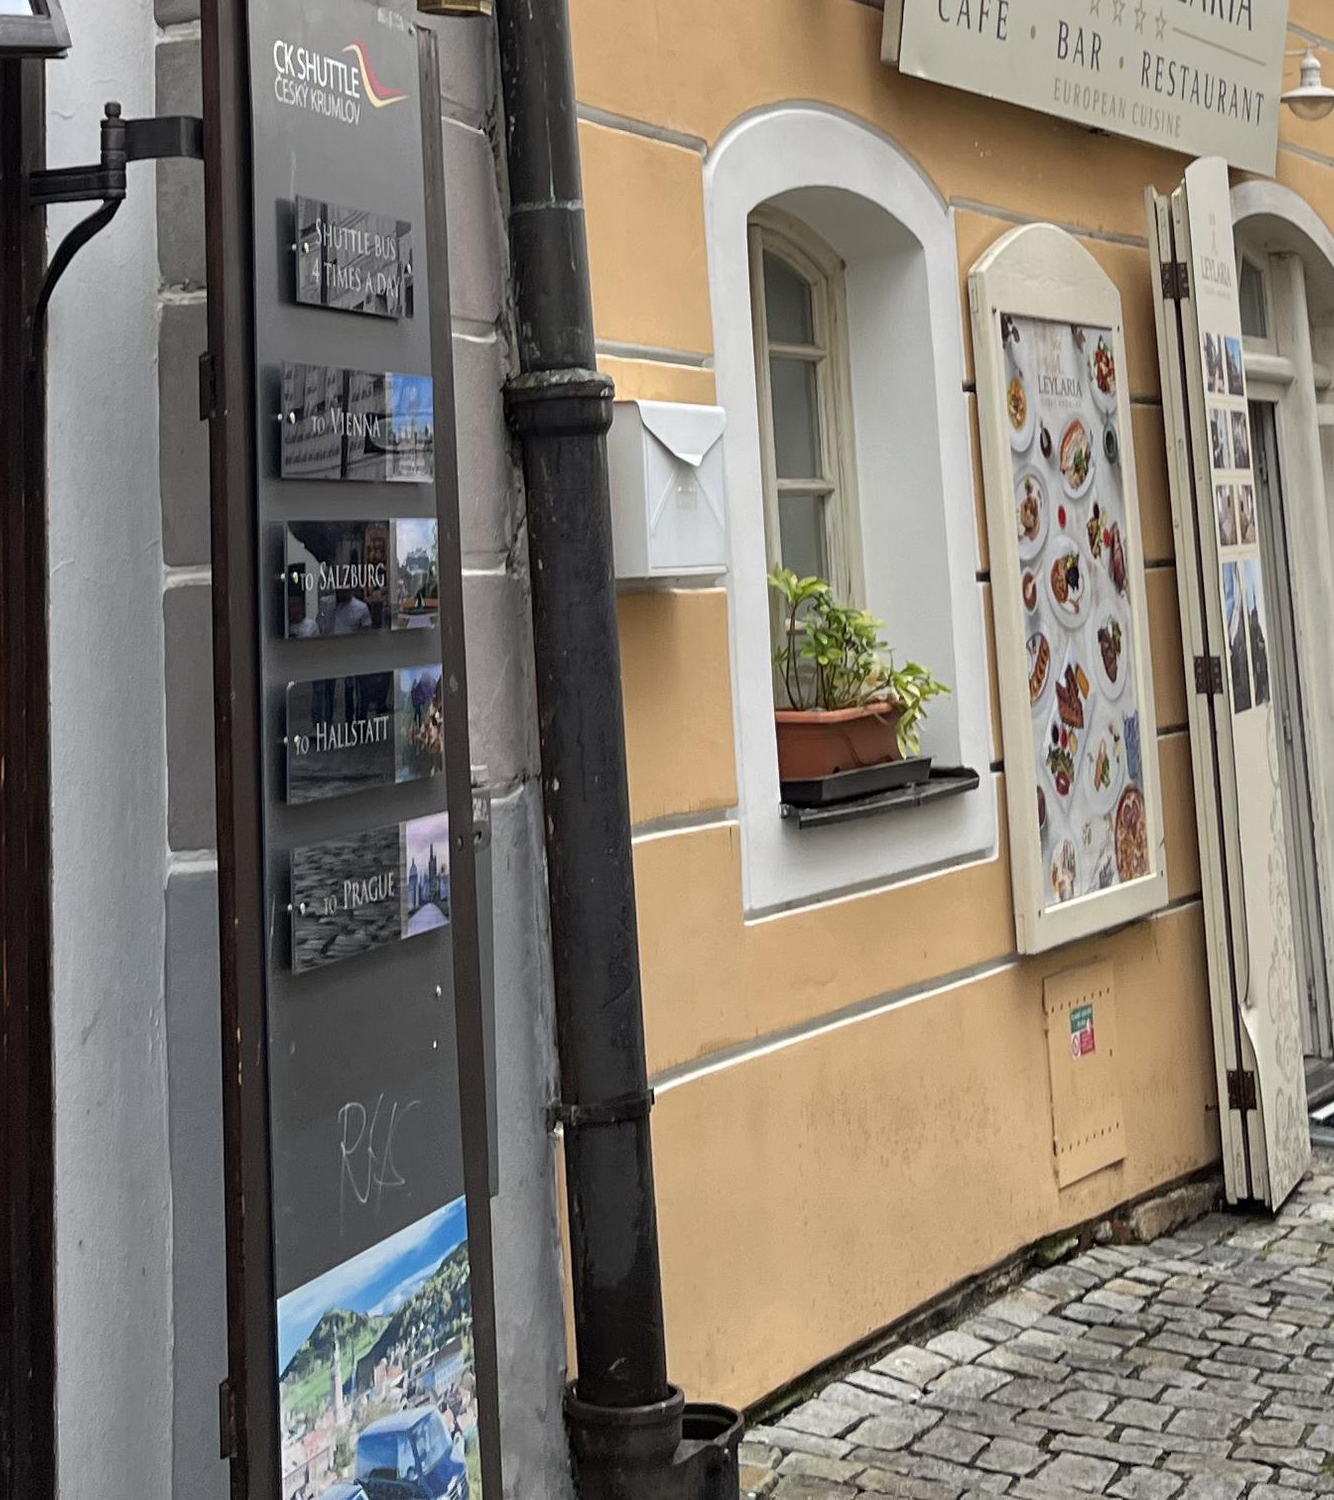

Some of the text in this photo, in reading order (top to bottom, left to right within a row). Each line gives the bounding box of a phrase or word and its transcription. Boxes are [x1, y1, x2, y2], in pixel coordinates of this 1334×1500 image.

[272, 39, 361, 99] CK SHUTTLE
[1056, 19, 1103, 73] BAR
[1141, 50, 1265, 127] RESTAURANT
[274, 73, 361, 126] ČESKÝ KRUMLOV
[1053, 77, 1182, 138] EUROPEAN CUISINE
[315, 217, 396, 261] SHUTTLE BUS
[312, 257, 401, 299] 4 TIMES A DAY
[1037, 374, 1083, 398] LEYLARIA
